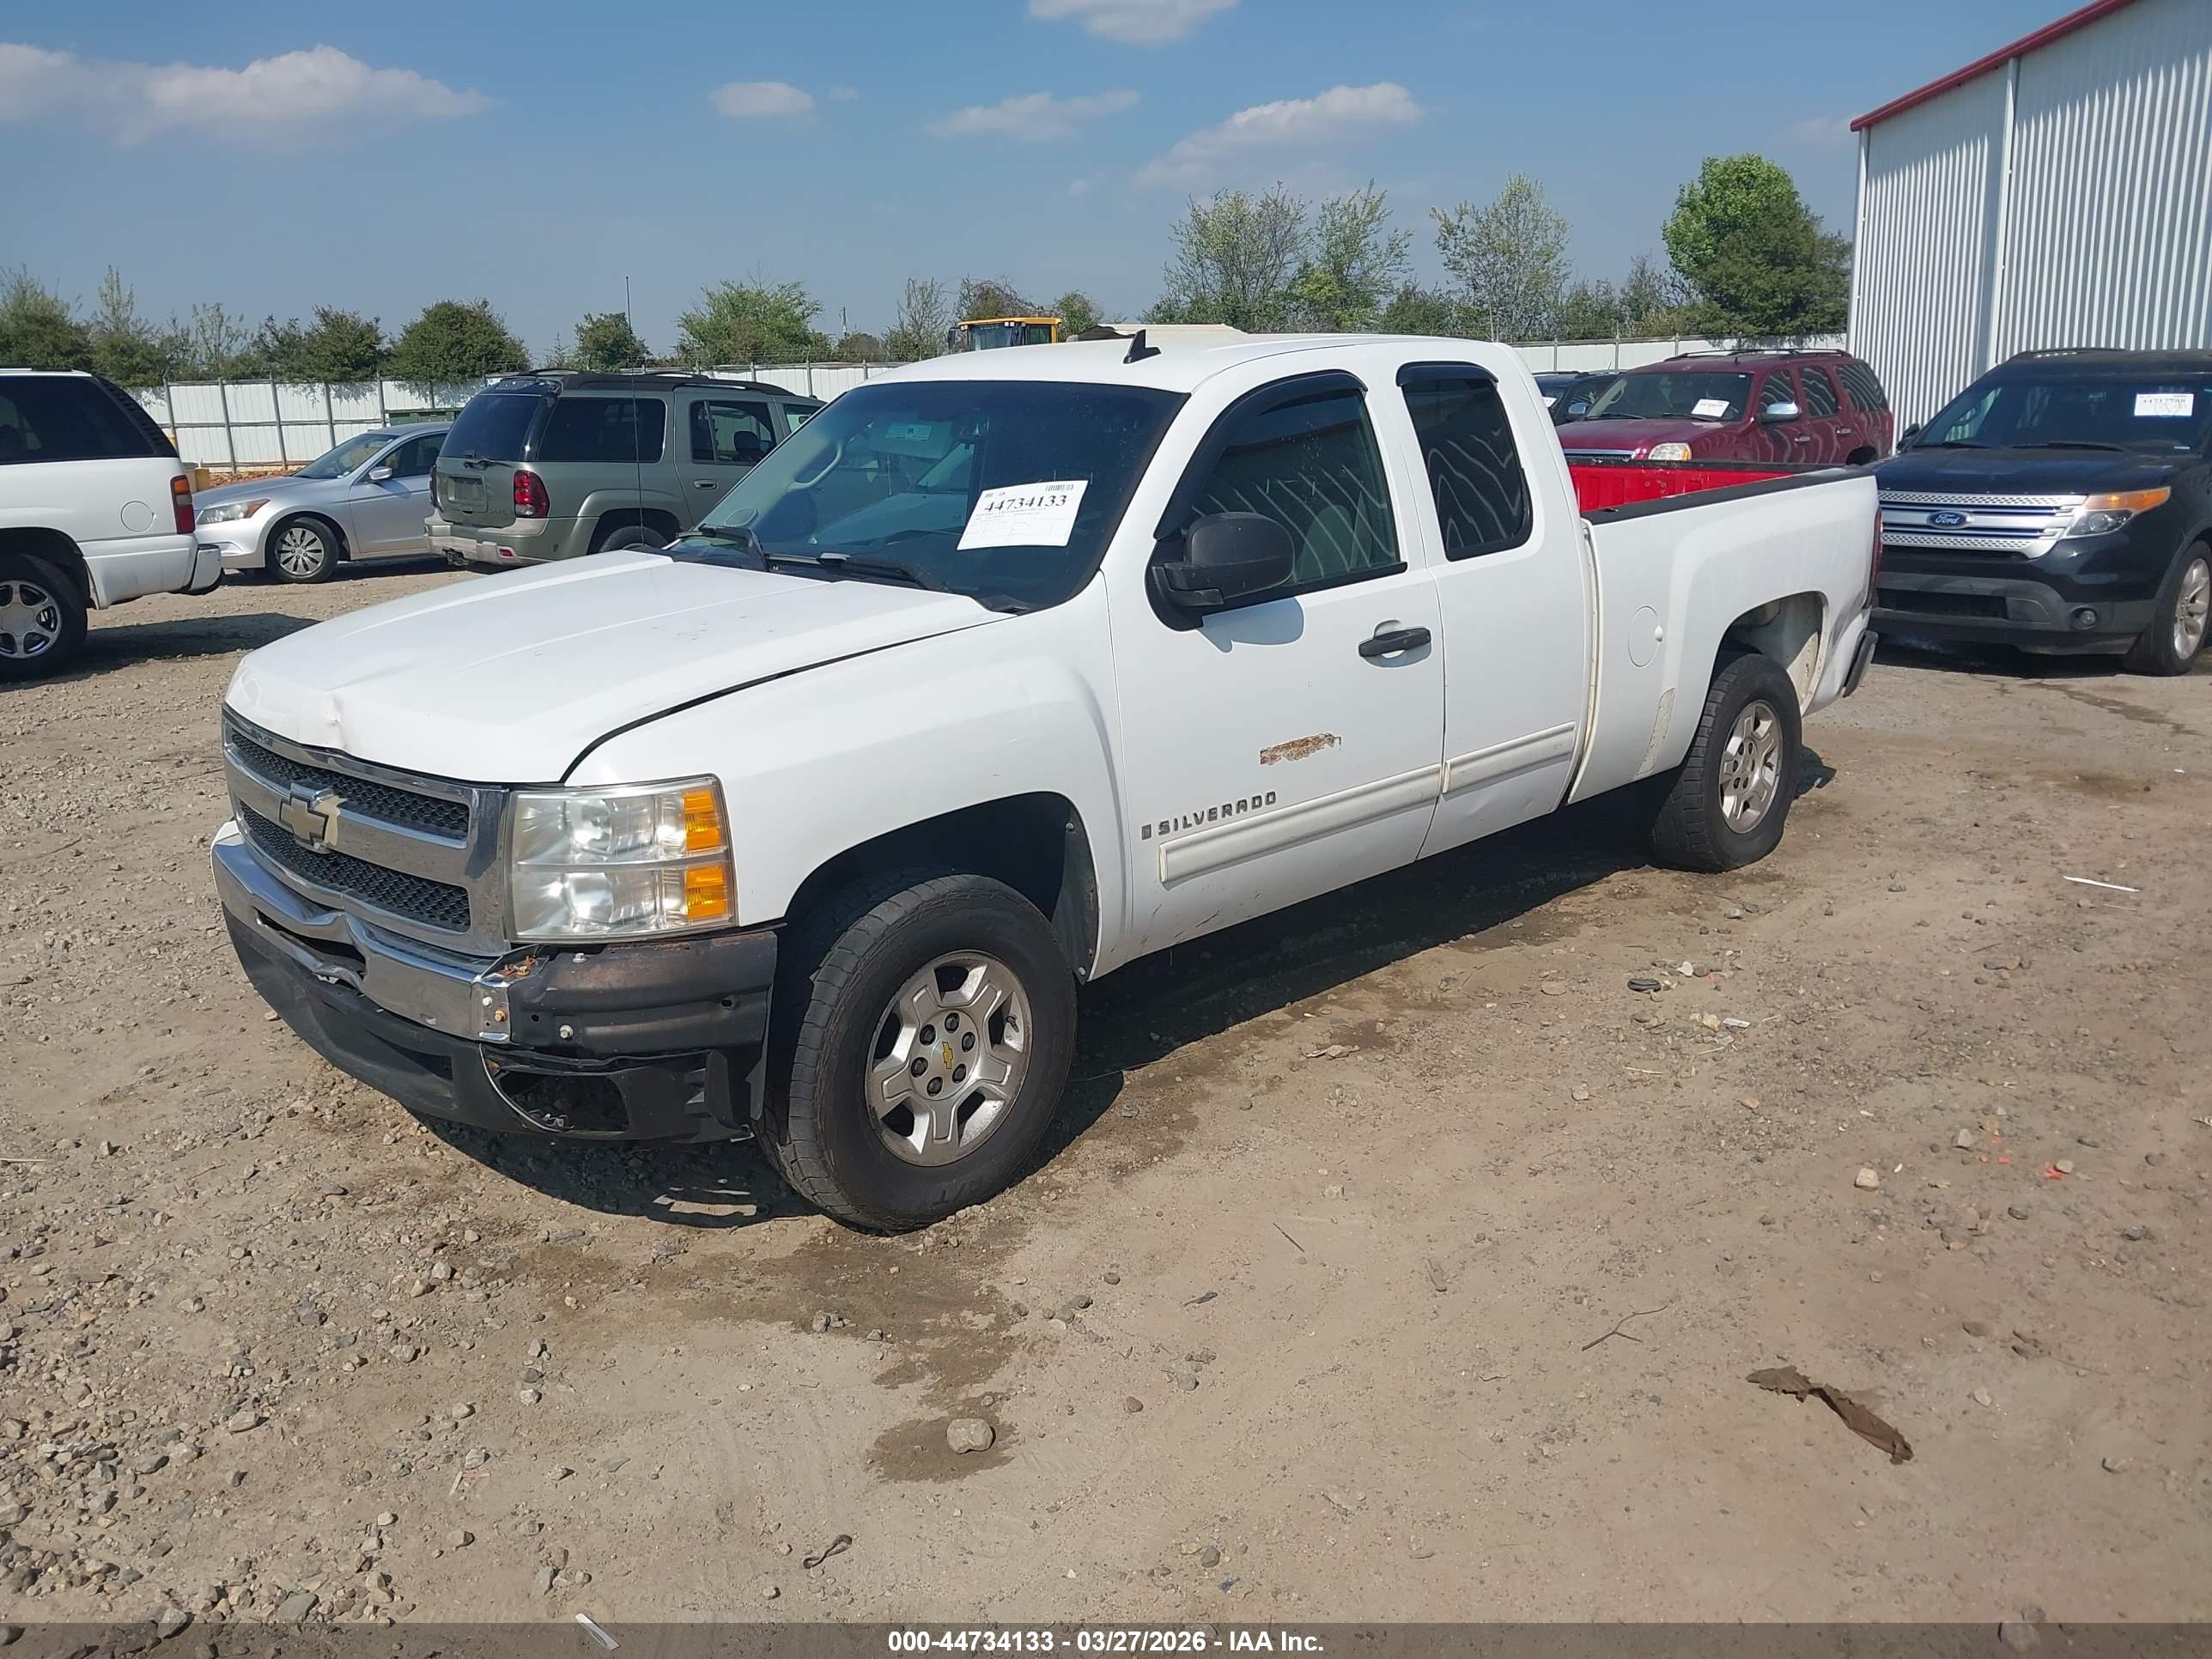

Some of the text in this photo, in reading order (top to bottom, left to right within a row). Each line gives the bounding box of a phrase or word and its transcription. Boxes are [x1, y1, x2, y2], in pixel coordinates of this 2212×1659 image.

[984, 495, 1067, 513] 44734133
[1935, 514, 1960, 524] Ford
[1158, 790, 1277, 836] SILVERADO
